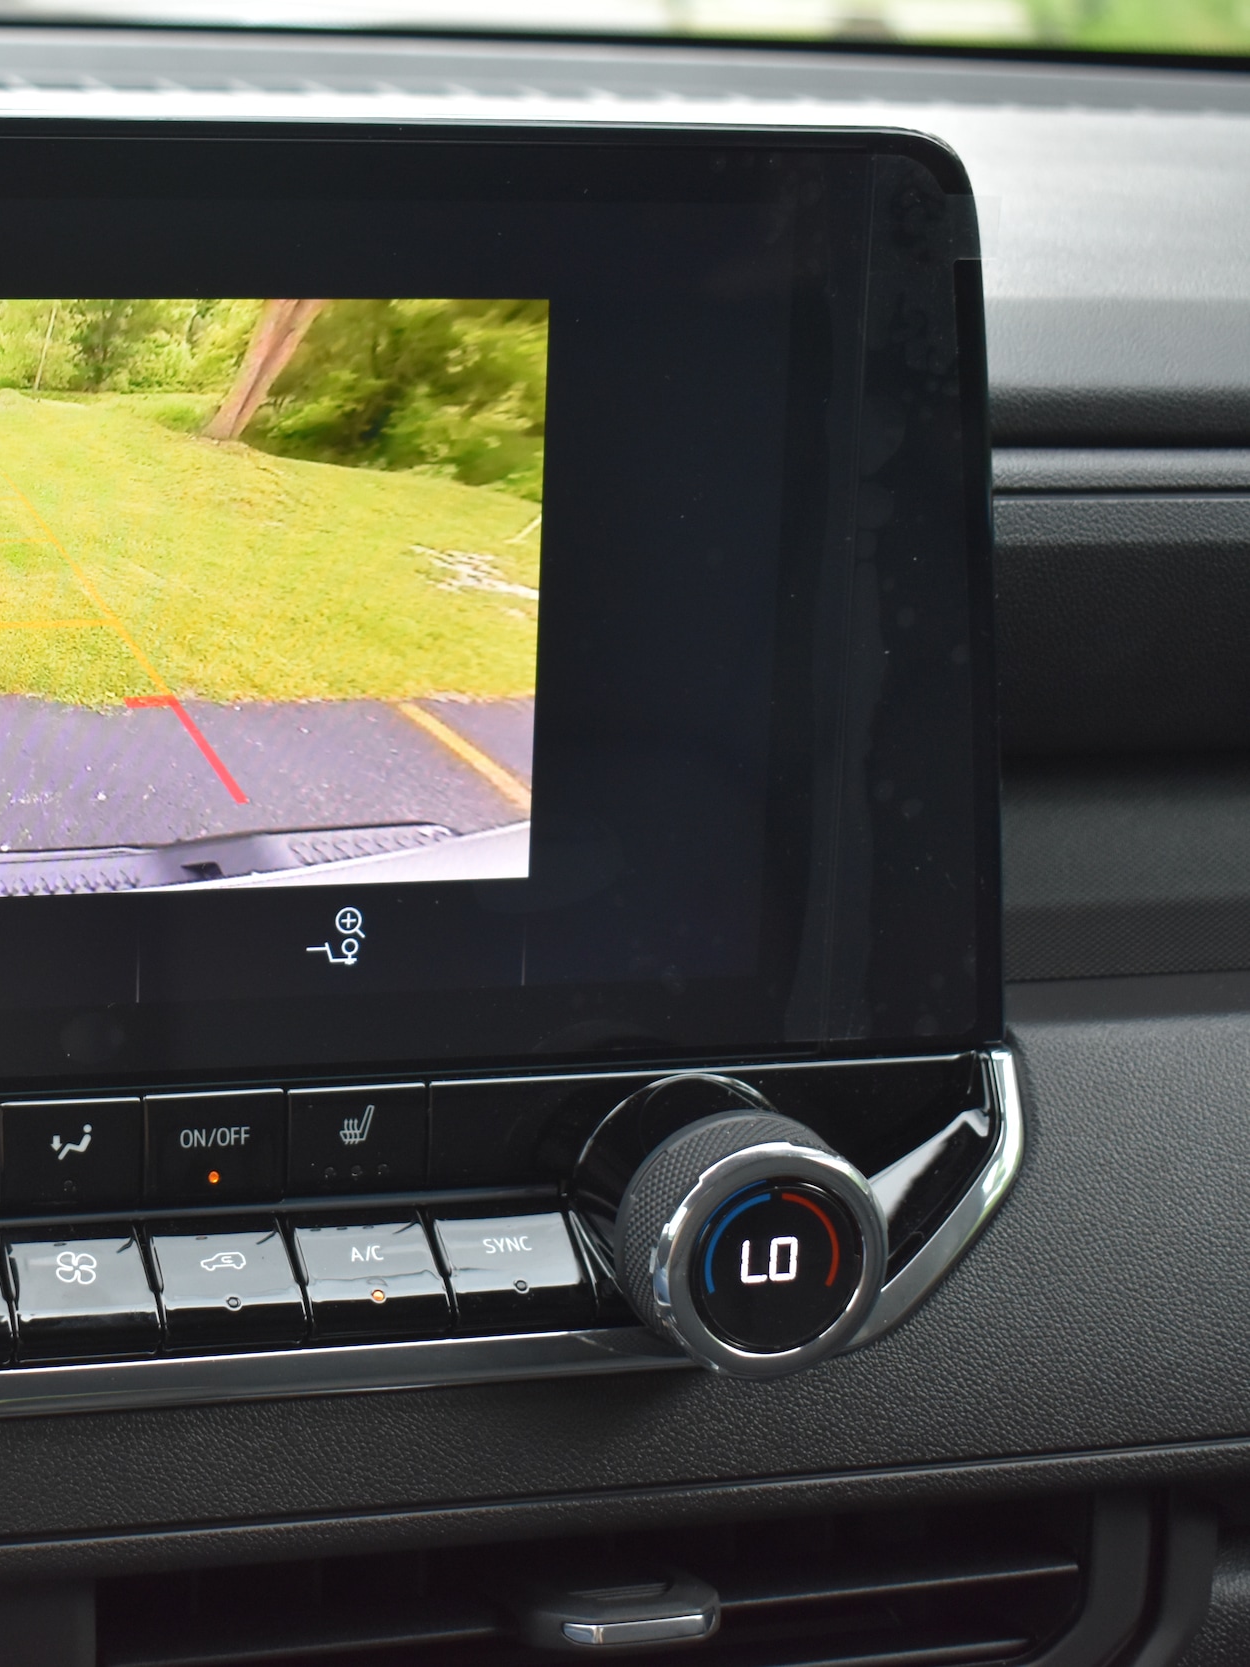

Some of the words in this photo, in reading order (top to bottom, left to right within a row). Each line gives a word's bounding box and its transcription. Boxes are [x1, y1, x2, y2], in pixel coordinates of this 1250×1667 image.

[180, 1125, 250, 1148] ON/OFF
[351, 1244, 385, 1262] A/C
[482, 1235, 533, 1254] SYNC
[740, 1236, 798, 1284] LO
